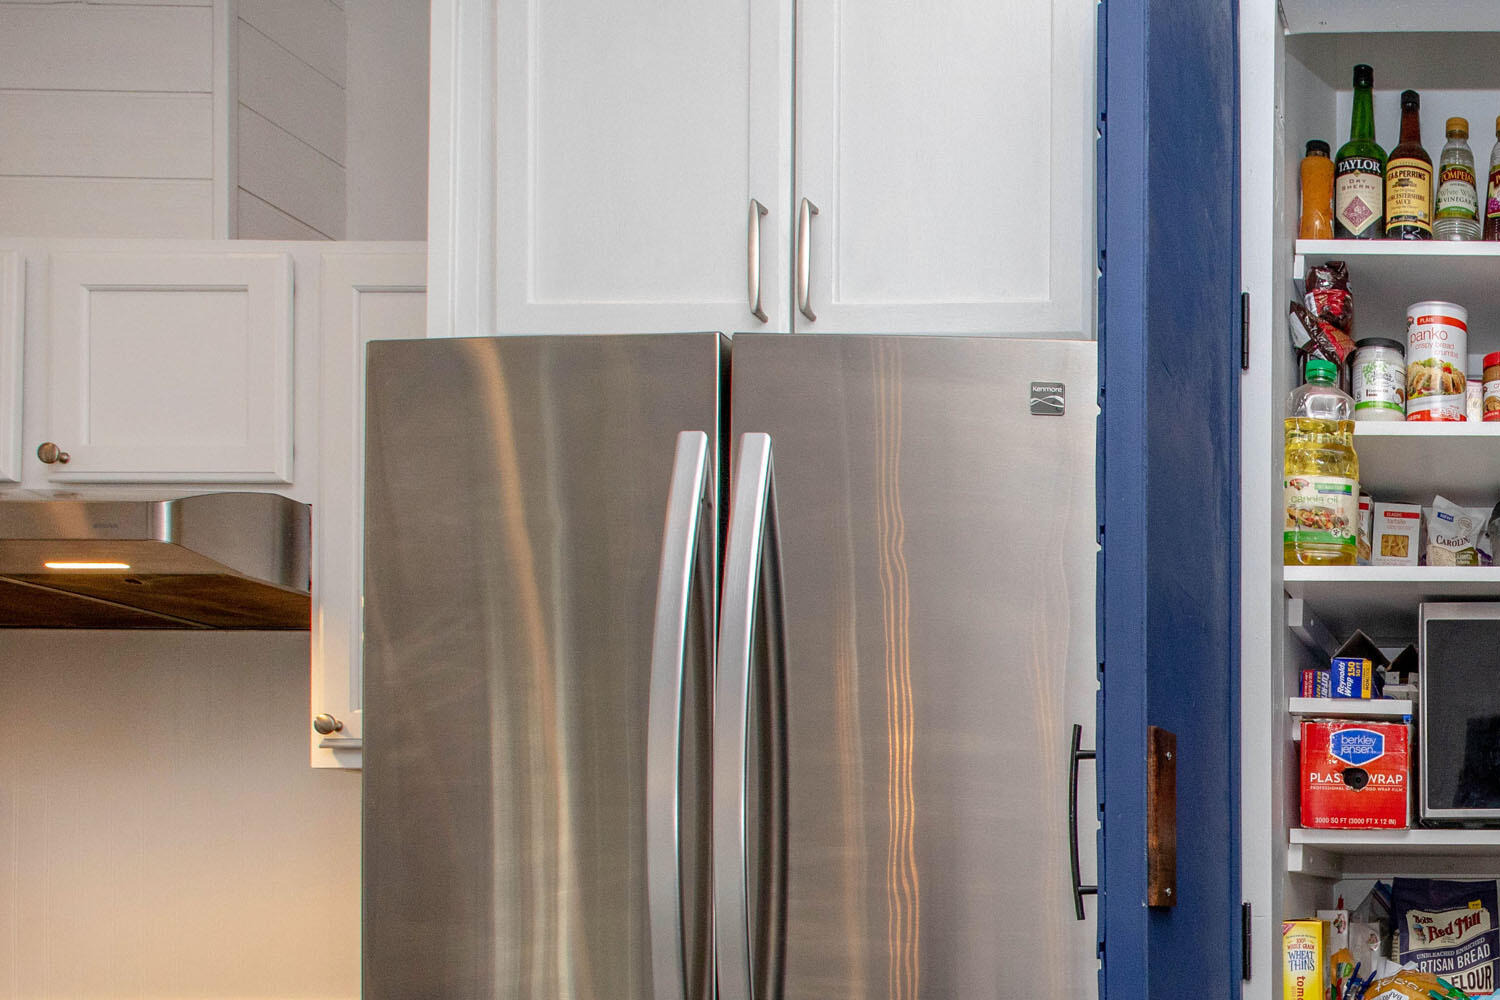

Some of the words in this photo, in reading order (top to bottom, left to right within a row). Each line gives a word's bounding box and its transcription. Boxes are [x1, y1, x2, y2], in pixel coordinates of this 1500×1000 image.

[1338, 159, 1381, 173] TAYLOR
[1410, 327, 1448, 346] panko
[1436, 535, 1471, 547] CAROLIN
[1347, 661, 1355, 677] 150
[1336, 662, 1346, 694] Reynolds
[1344, 677, 1354, 696] Wrap
[1341, 735, 1376, 745] berkley
[1340, 746, 1374, 756] jensen
[1310, 772, 1343, 783] PLAS
[1368, 774, 1403, 784] WRAP
[1426, 921, 1454, 944] Red
[1454, 911, 1482, 939] Mill
[1287, 950, 1315, 960] WHEAT
[1416, 951, 1455, 960] UNBLEACHED
[1455, 937, 1486, 956] ENRICHED
[1457, 943, 1491, 969] BREAD
[1288, 960, 1315, 971] THINS
[1451, 965, 1492, 990] FLOUR
